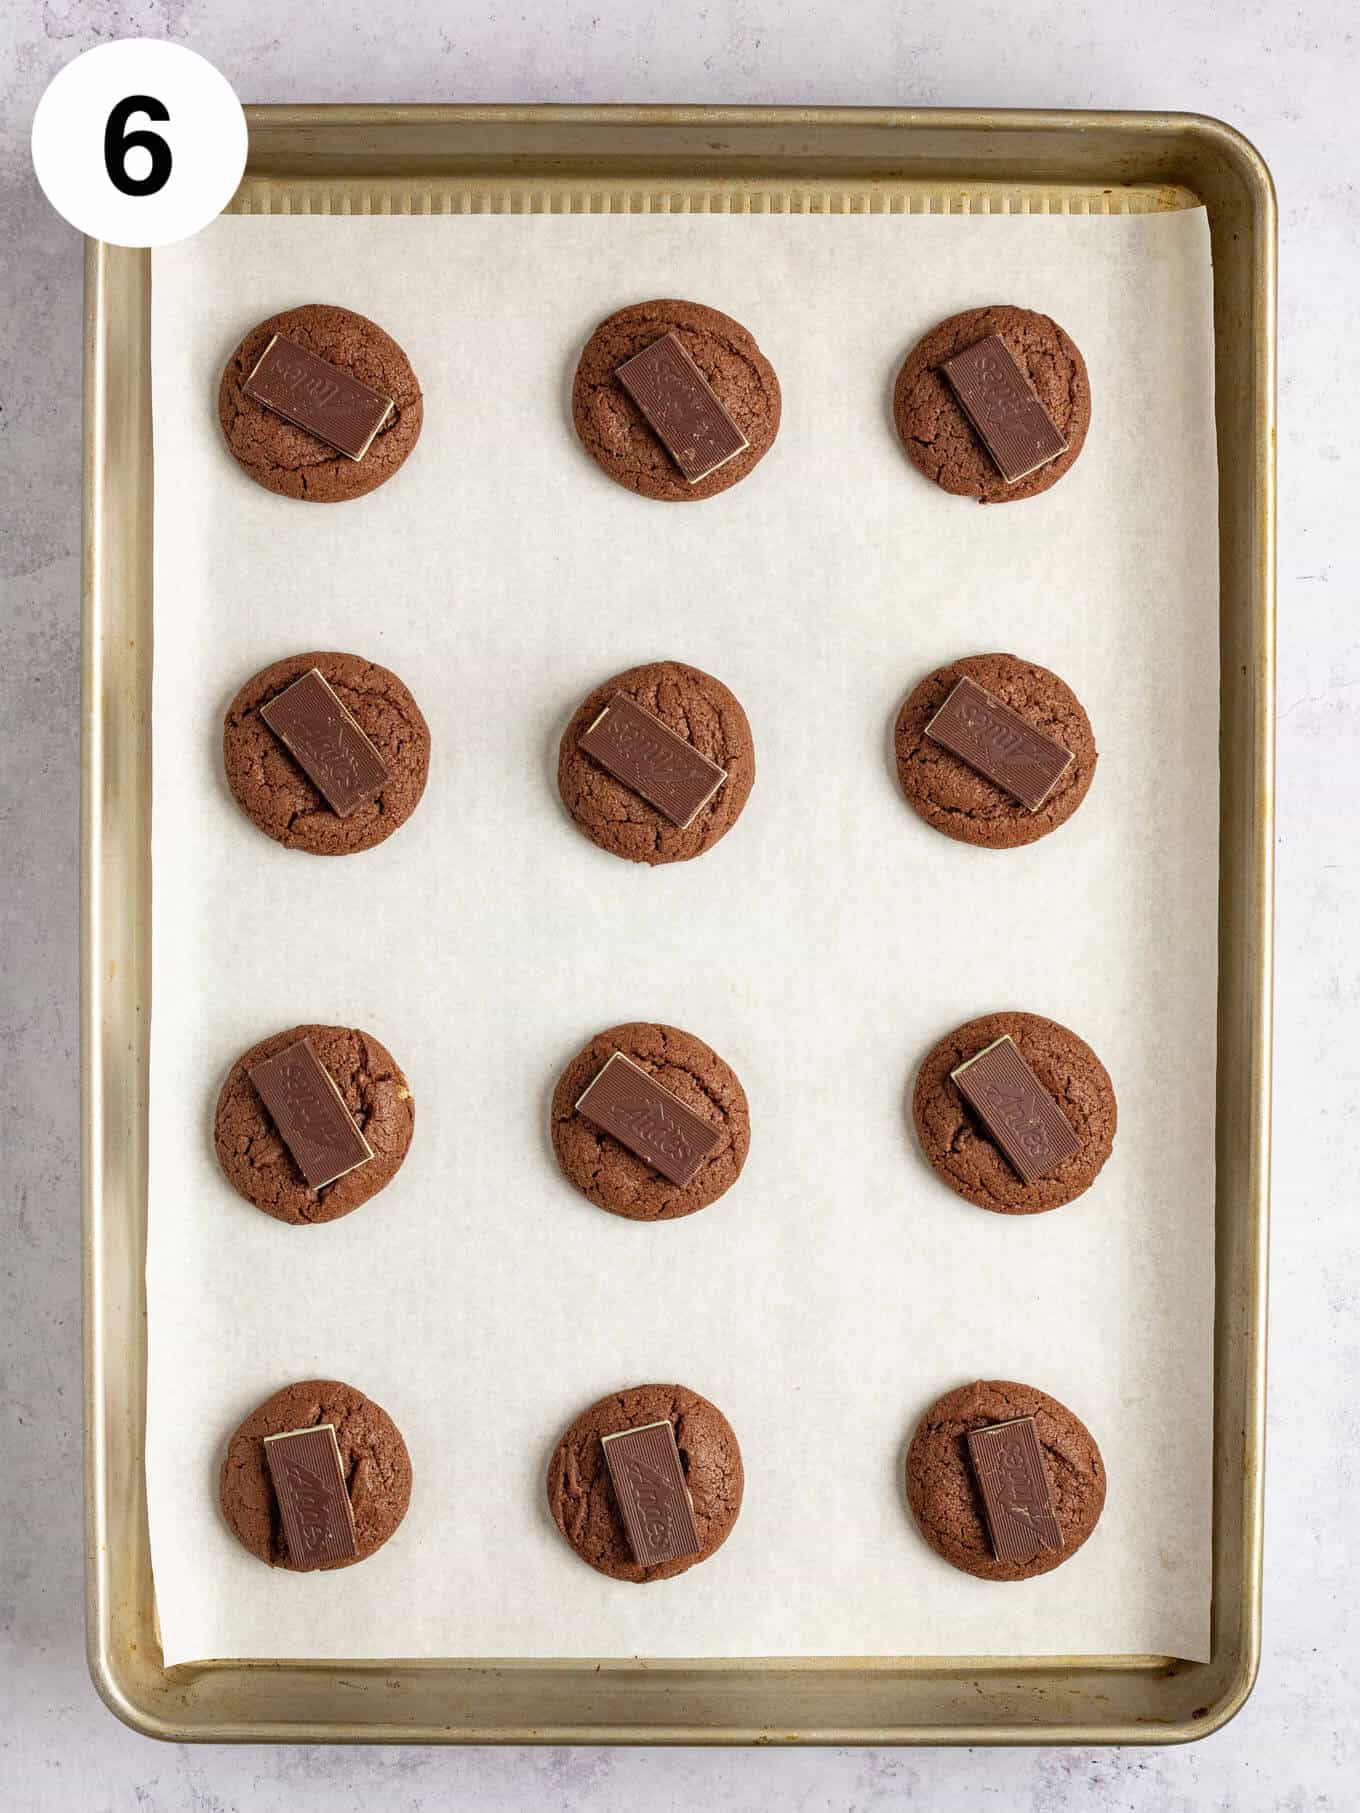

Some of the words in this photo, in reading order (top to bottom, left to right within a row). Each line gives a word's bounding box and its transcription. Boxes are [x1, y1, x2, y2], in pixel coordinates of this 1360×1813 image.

[953, 700, 1037, 762] Andes
[609, 1107, 694, 1166] Andes
[984, 1088, 1052, 1161] Andes
[291, 1467, 330, 1552] Andes
[629, 1462, 669, 1551] Andes
[1000, 1438, 1037, 1527] Andes
